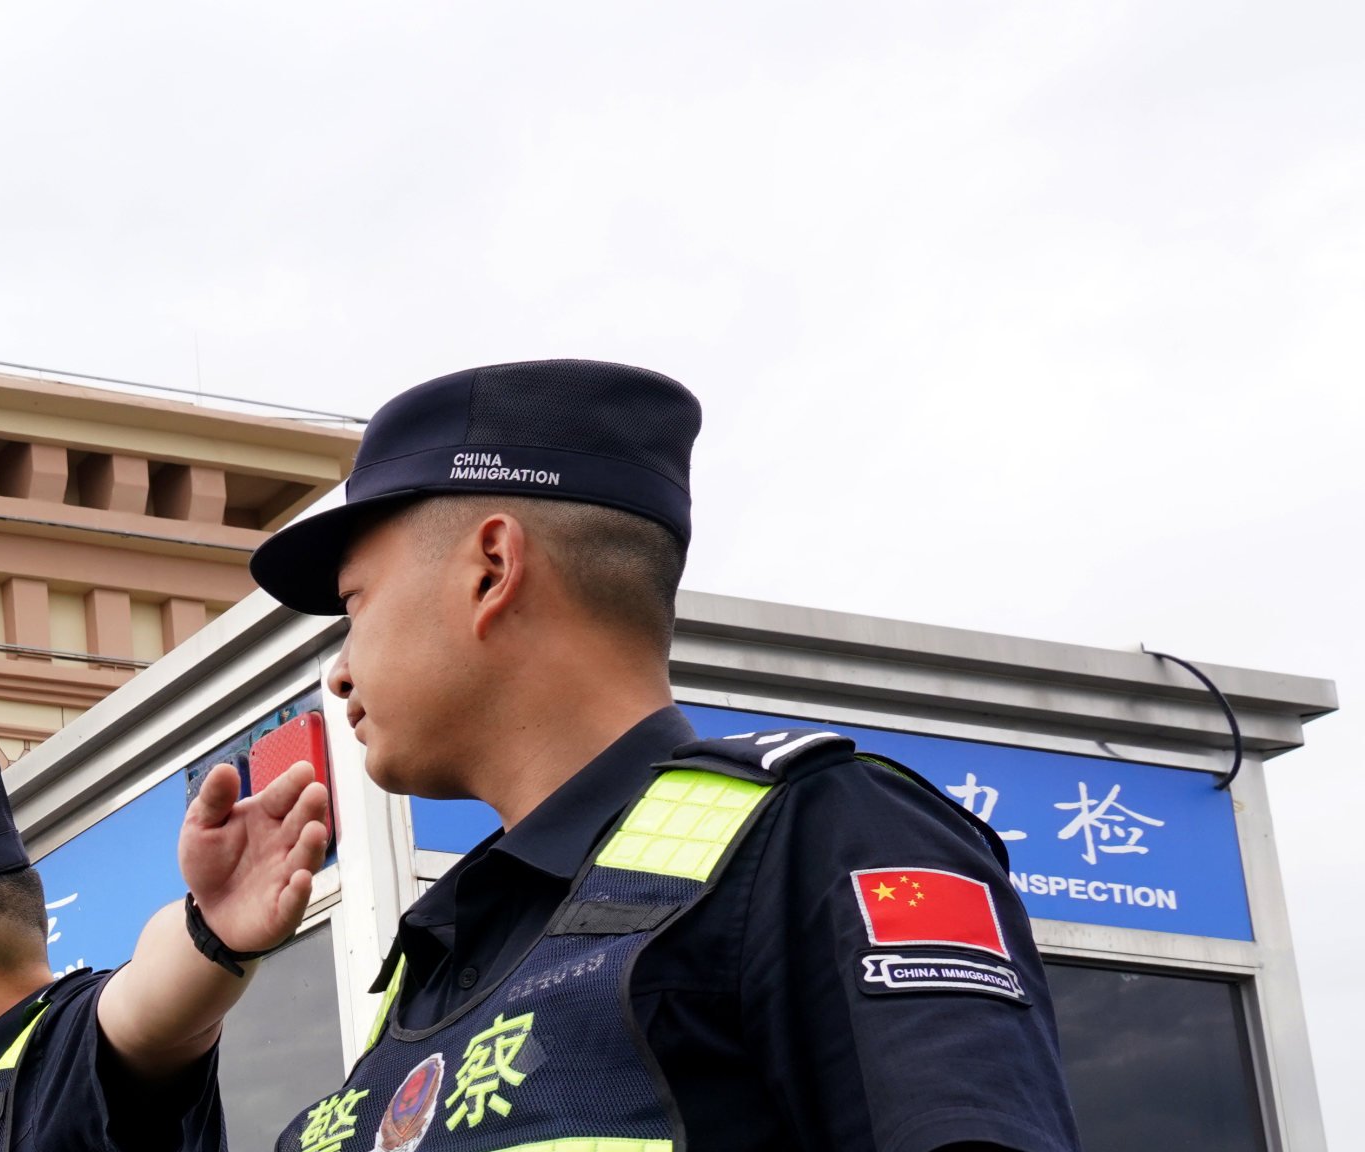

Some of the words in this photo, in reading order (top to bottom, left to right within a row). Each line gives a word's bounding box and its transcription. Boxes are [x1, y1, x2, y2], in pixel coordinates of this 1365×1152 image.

[454, 453, 502, 466] CHINA
[450, 467, 560, 485] IMMIGRATION
[1009, 871, 1178, 911] NSPECTION
[893, 967, 939, 979] CHINA
[941, 968, 1012, 989] IMMIGRATION
